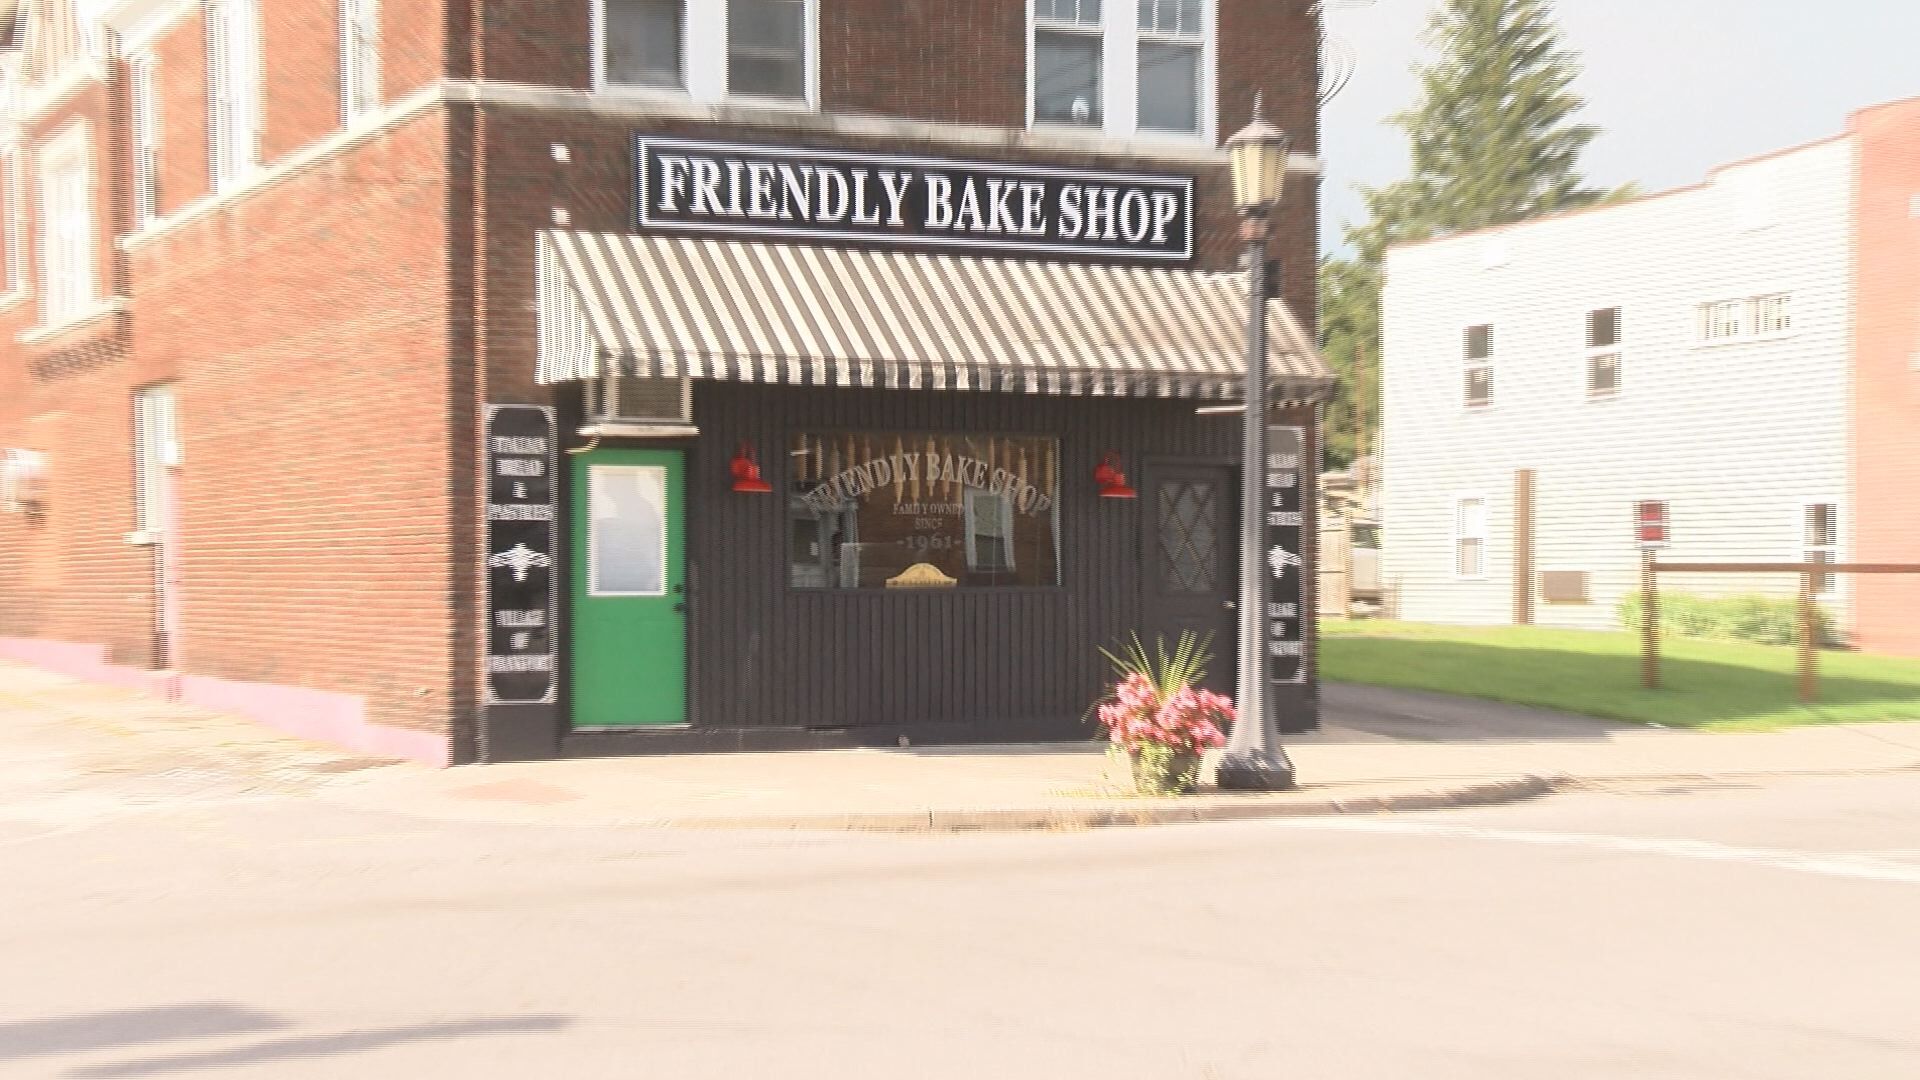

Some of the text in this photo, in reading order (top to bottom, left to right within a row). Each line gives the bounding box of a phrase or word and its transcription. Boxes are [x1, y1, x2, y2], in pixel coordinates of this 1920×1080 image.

[656, 154, 1180, 244] FRIENDLY BAKE SHOP
[801, 452, 1052, 518] FRIENDLY BAKE SHOP
